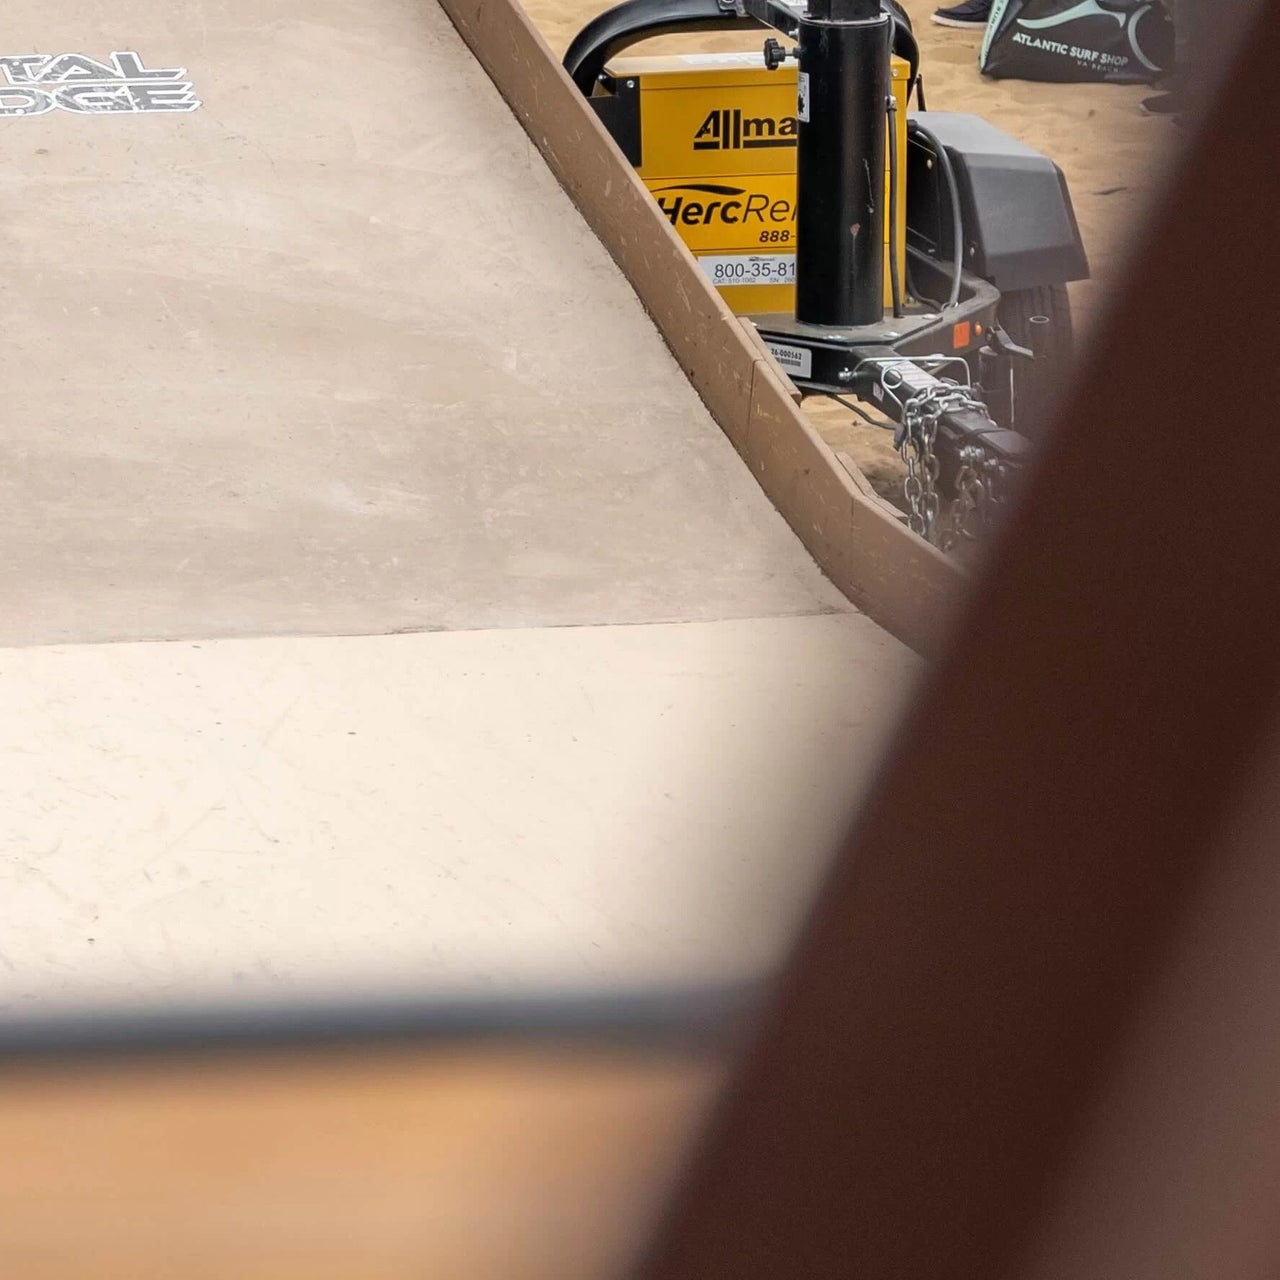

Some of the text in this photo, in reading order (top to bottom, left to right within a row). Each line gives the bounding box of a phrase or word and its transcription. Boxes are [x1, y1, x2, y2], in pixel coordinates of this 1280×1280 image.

[1013, 32, 1129, 67] ATLANTIC SURF SHOP
[693, 109, 798, 151] Allma
[657, 193, 798, 227] HercRe
[759, 230, 797, 243] 888-
[714, 262, 796, 279] 800-35-81
